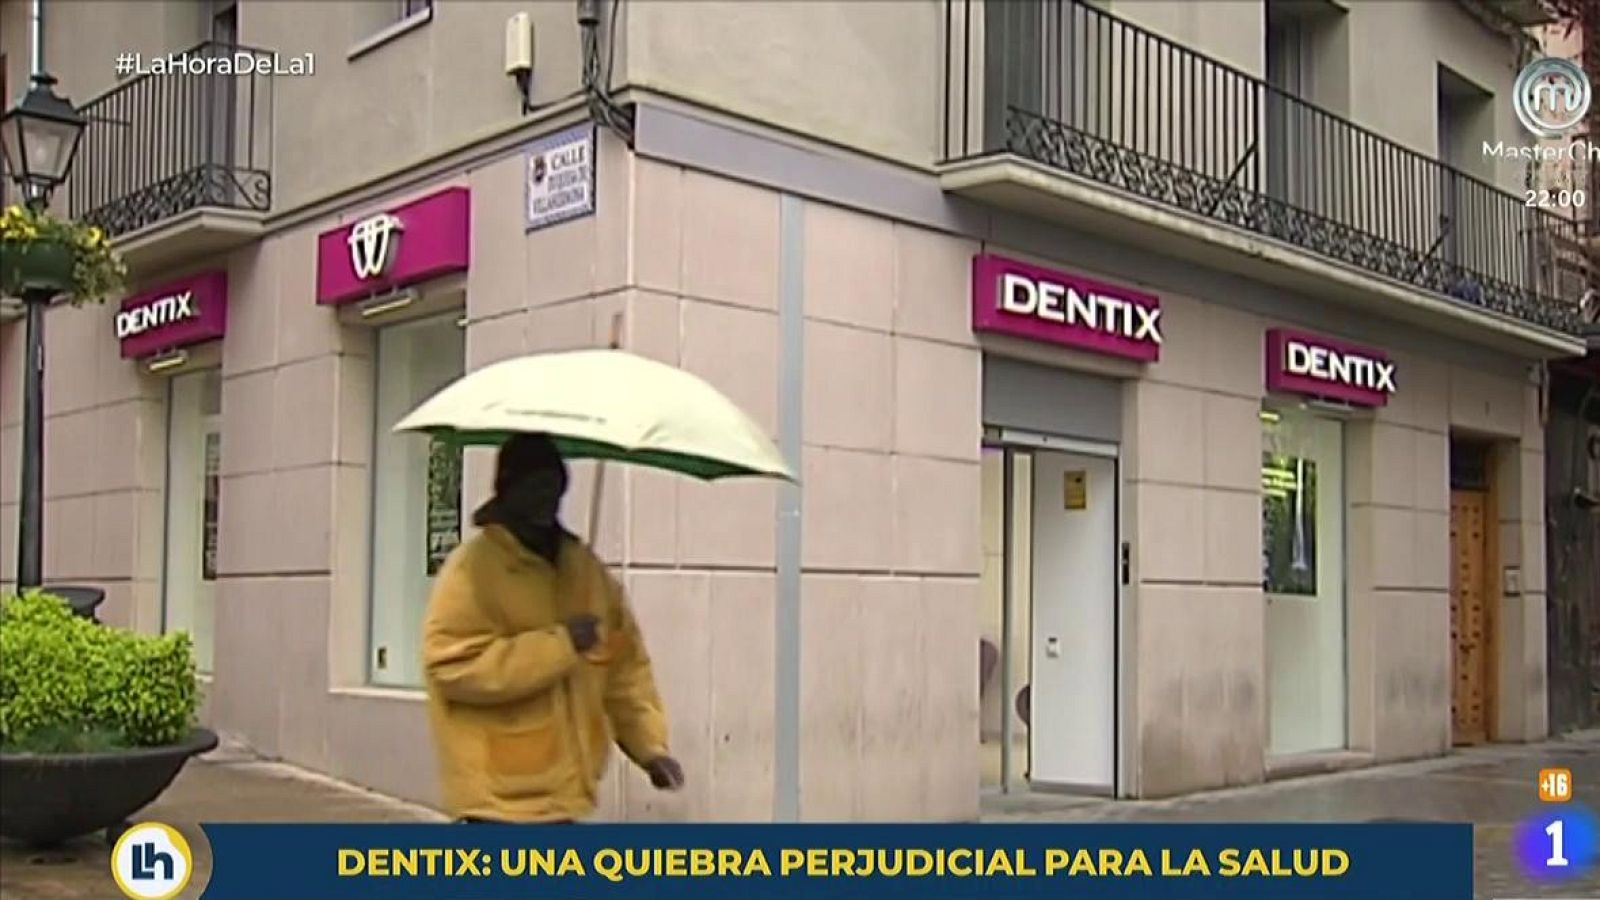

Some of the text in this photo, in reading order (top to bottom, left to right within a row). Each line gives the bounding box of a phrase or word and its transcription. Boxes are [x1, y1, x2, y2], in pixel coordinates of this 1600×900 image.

[550, 144, 586, 172] CALLE
[117, 290, 192, 338] DENTIX
[1003, 272, 1162, 343] DENTIX
[1287, 341, 1396, 393] DENTIX
